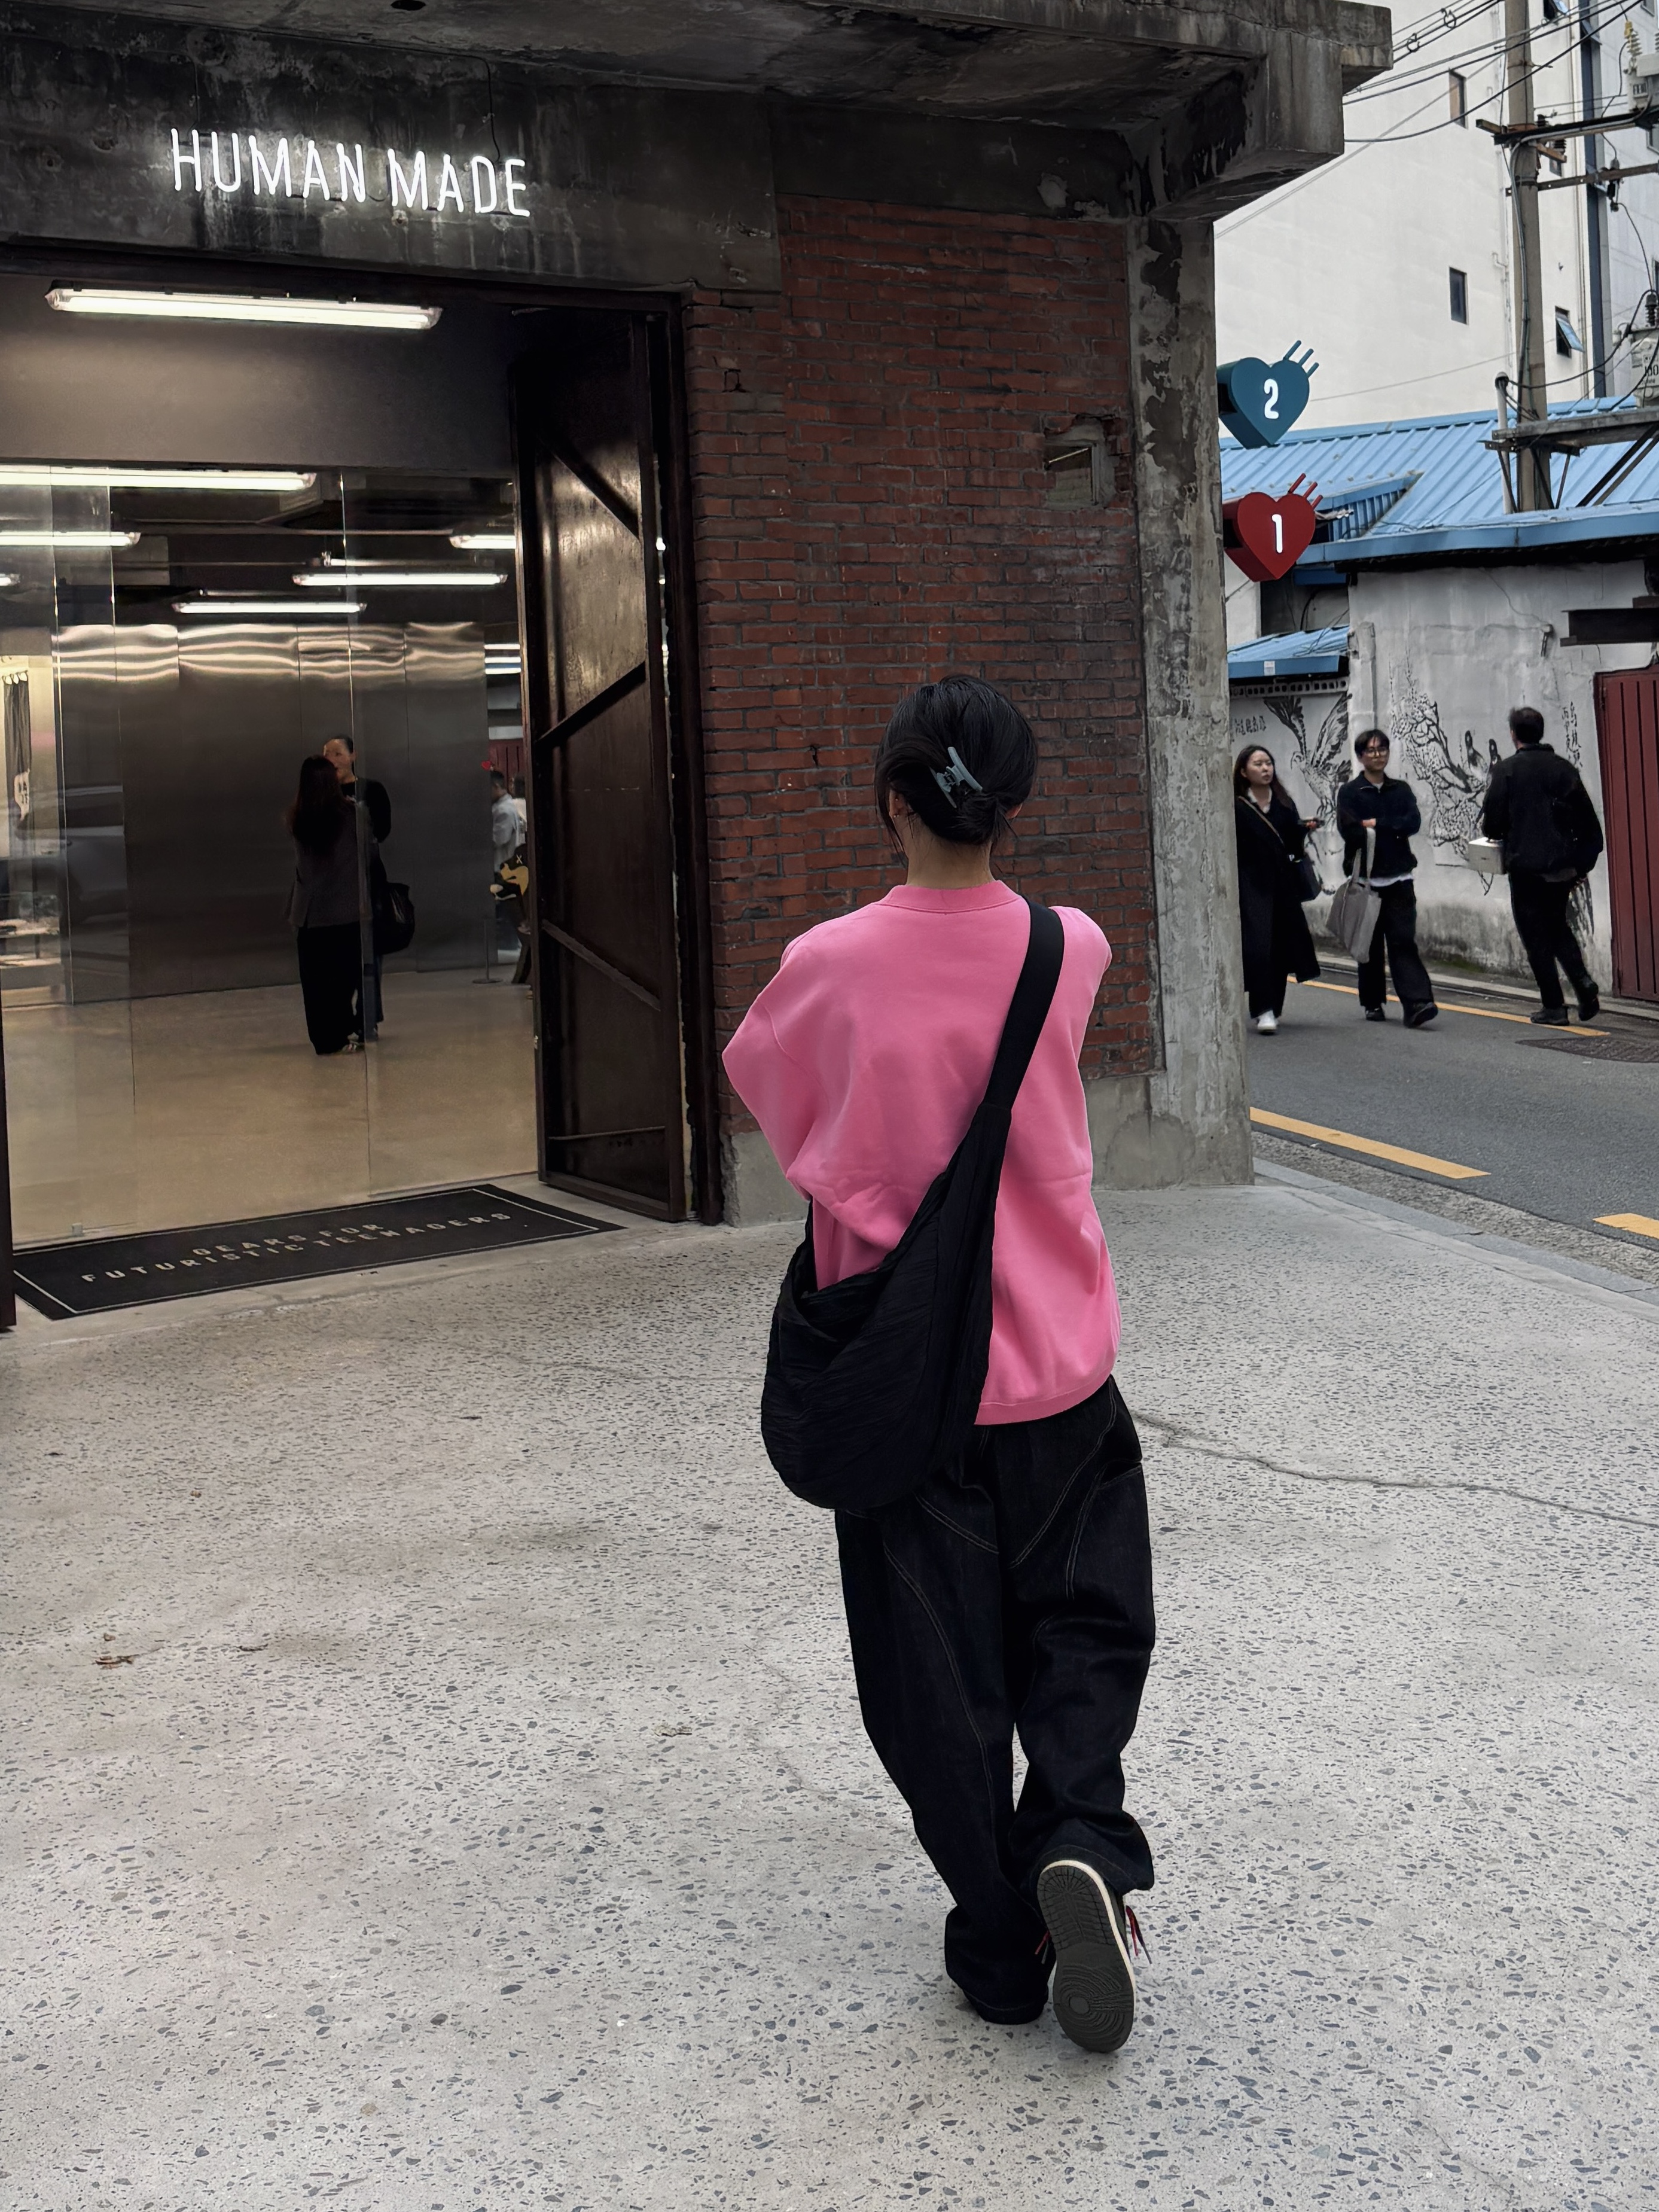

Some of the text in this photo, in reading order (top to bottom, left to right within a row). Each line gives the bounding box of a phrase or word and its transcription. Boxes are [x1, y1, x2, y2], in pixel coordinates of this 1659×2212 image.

[171, 128, 530, 217] HUMAN MADE
[1264, 378, 1279, 419] 2
[1271, 514, 1283, 553] 1
[81, 1213, 511, 1282] FUTURISTIC TEENAGERS
[193, 1224, 384, 1256] GEARS FOR
